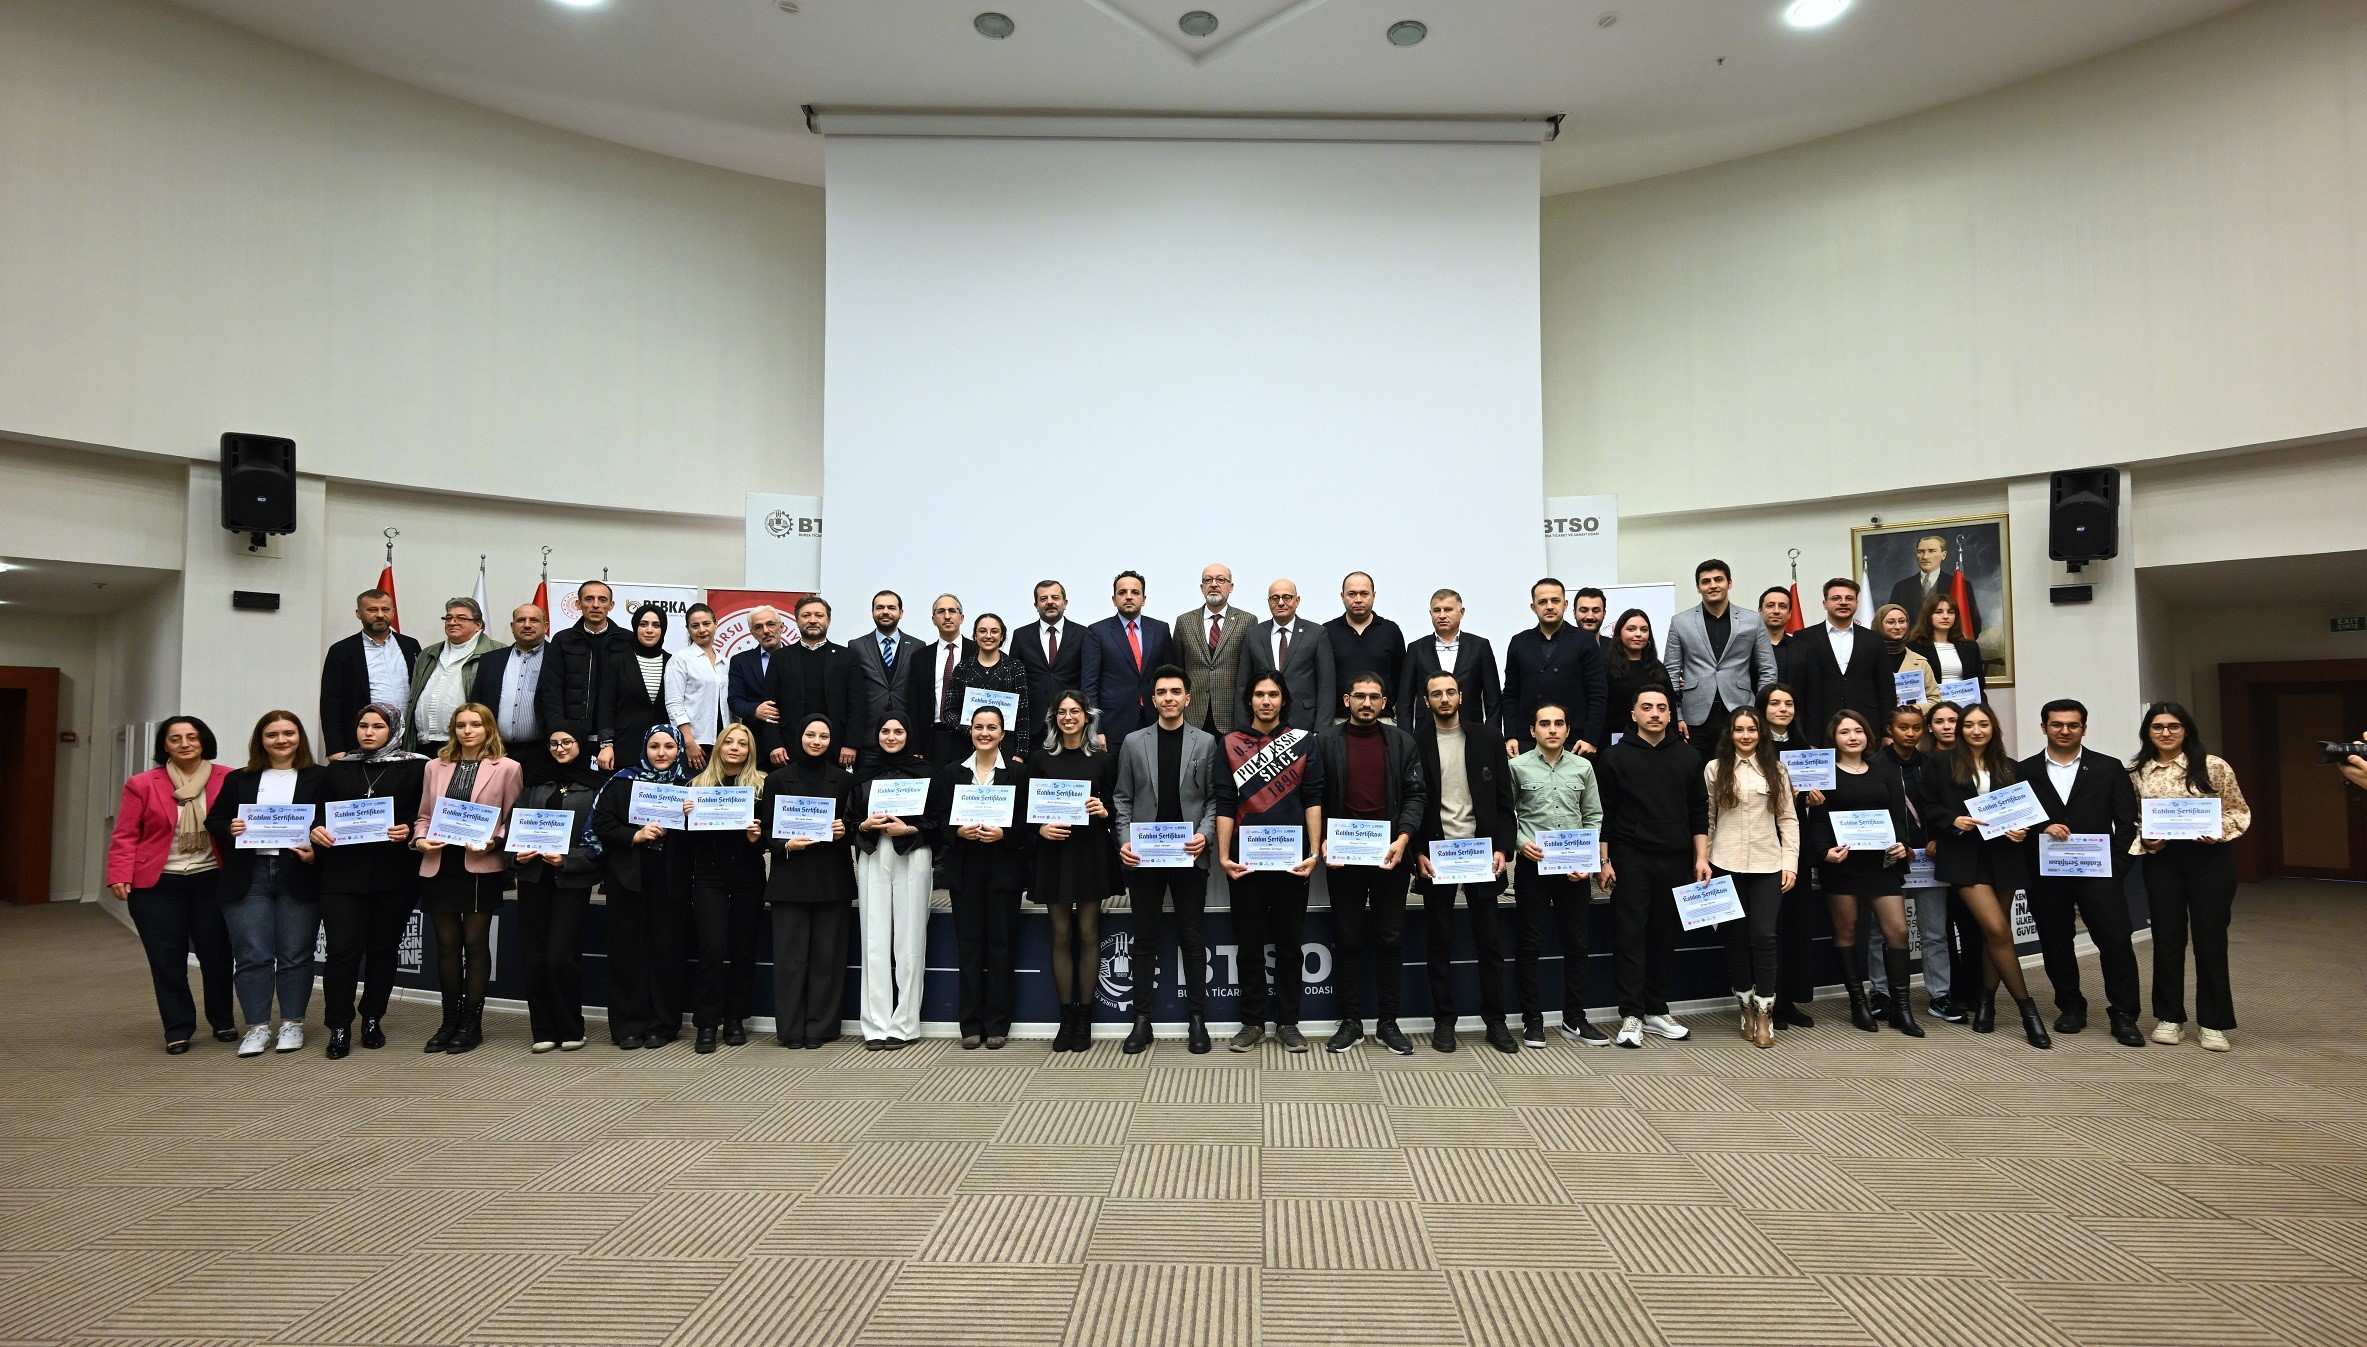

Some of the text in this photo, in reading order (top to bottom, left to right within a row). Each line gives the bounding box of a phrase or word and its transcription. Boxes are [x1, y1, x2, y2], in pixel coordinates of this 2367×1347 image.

[1544, 517, 1599, 533] BTSO
[1237, 752, 1269, 781] POLO
[1260, 748, 1299, 782] SINCE
[1267, 768, 1299, 798] 1890
[1304, 985, 1333, 995] ODASI
